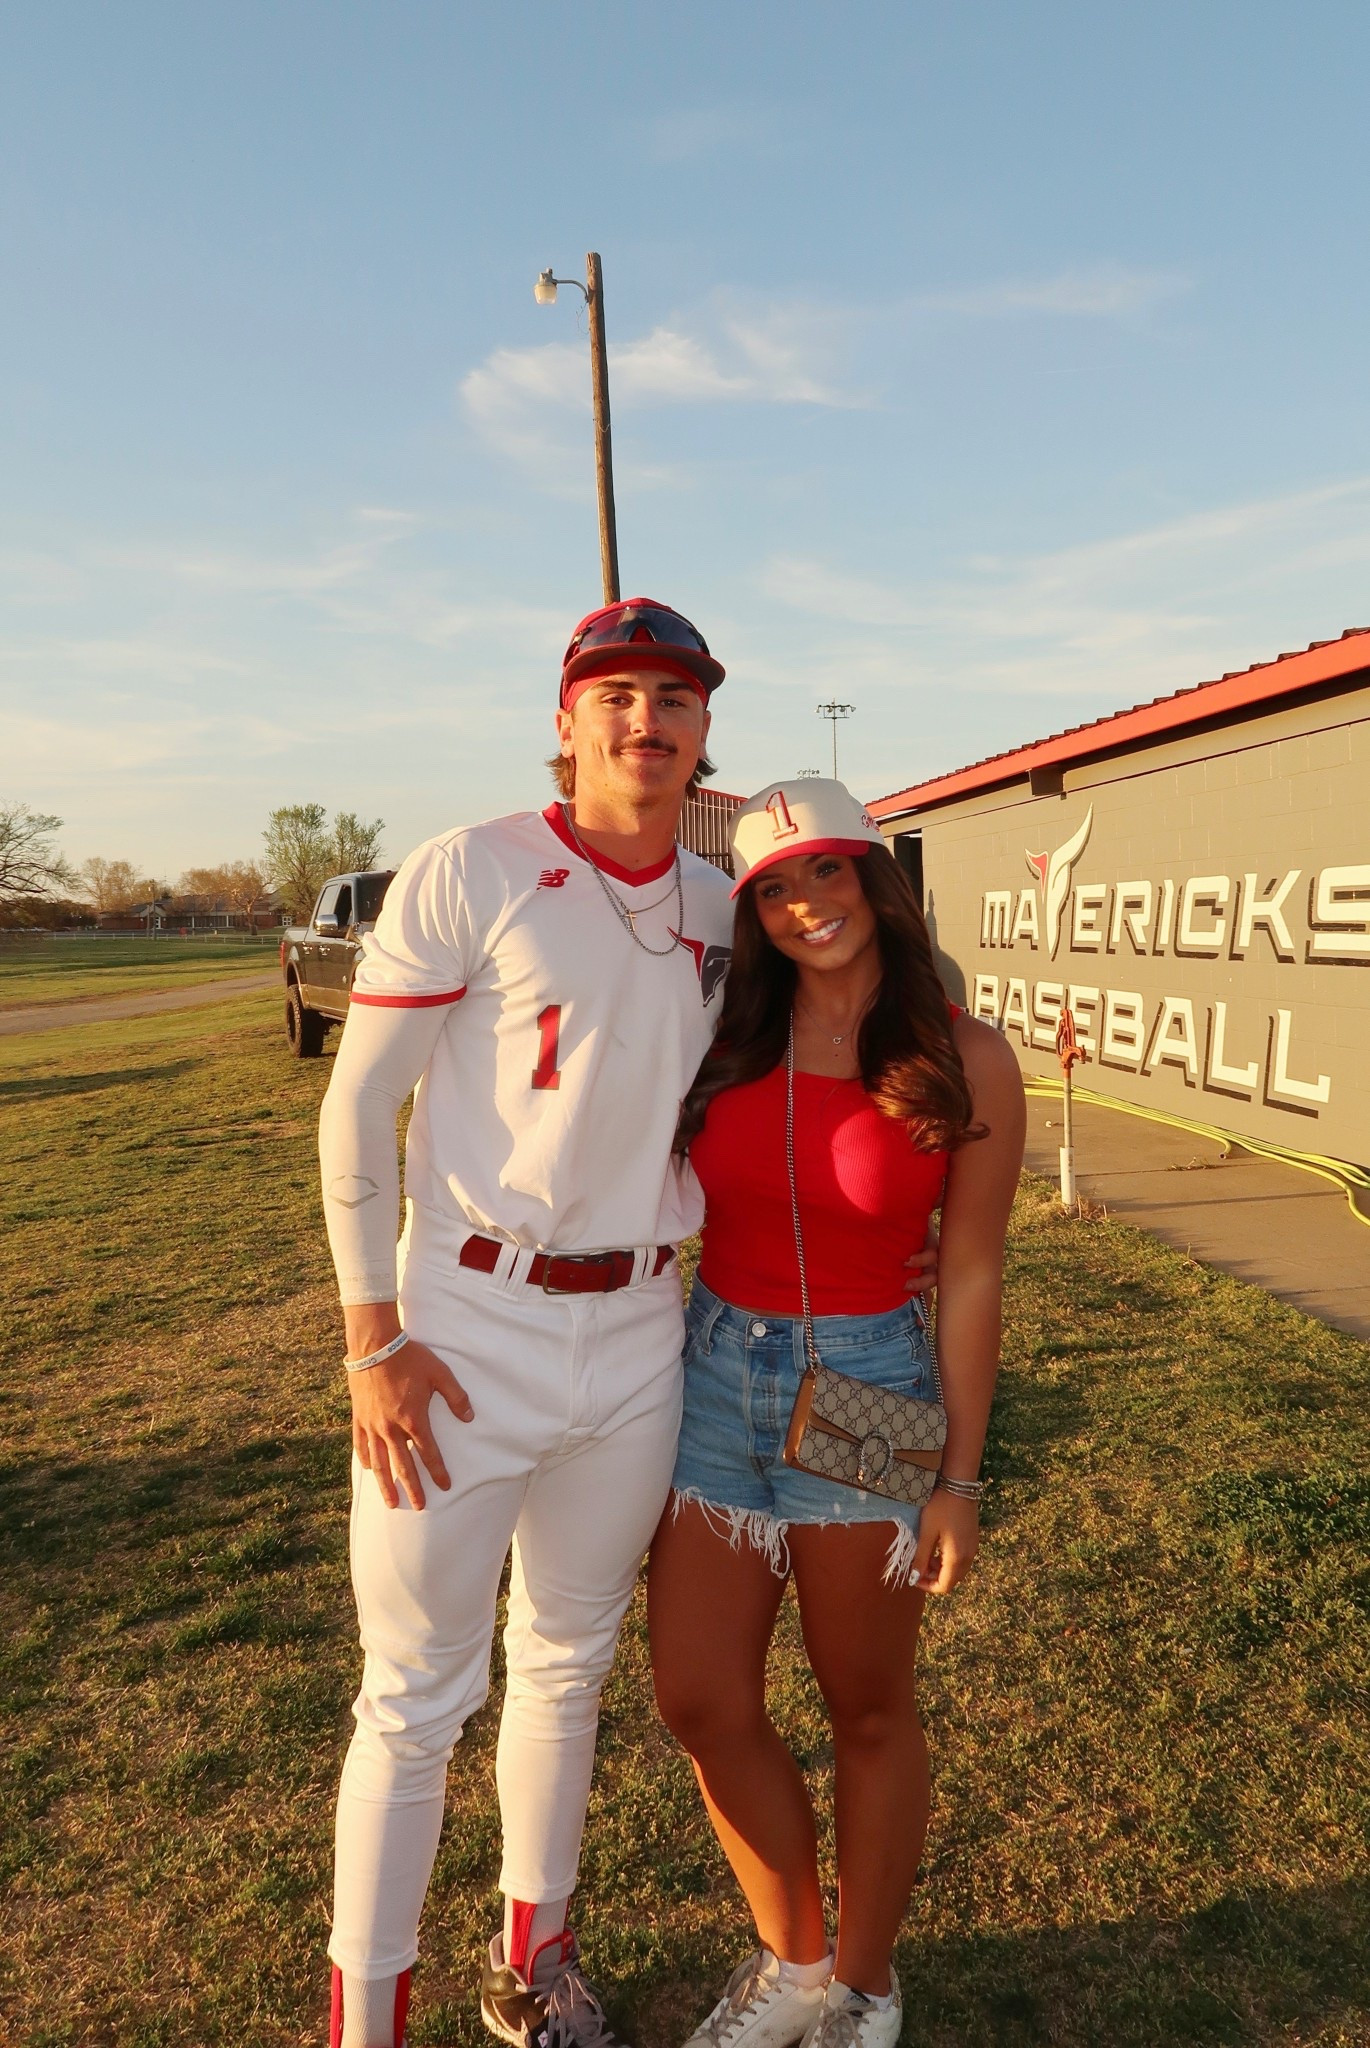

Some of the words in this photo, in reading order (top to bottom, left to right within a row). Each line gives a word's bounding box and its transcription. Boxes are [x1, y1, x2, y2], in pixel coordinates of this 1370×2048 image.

[765, 790, 799, 841] 1
[980, 802, 1370, 967] MAVERICKS
[531, 1004, 561, 1090] 1
[972, 973, 1331, 1116] BASEBALL
